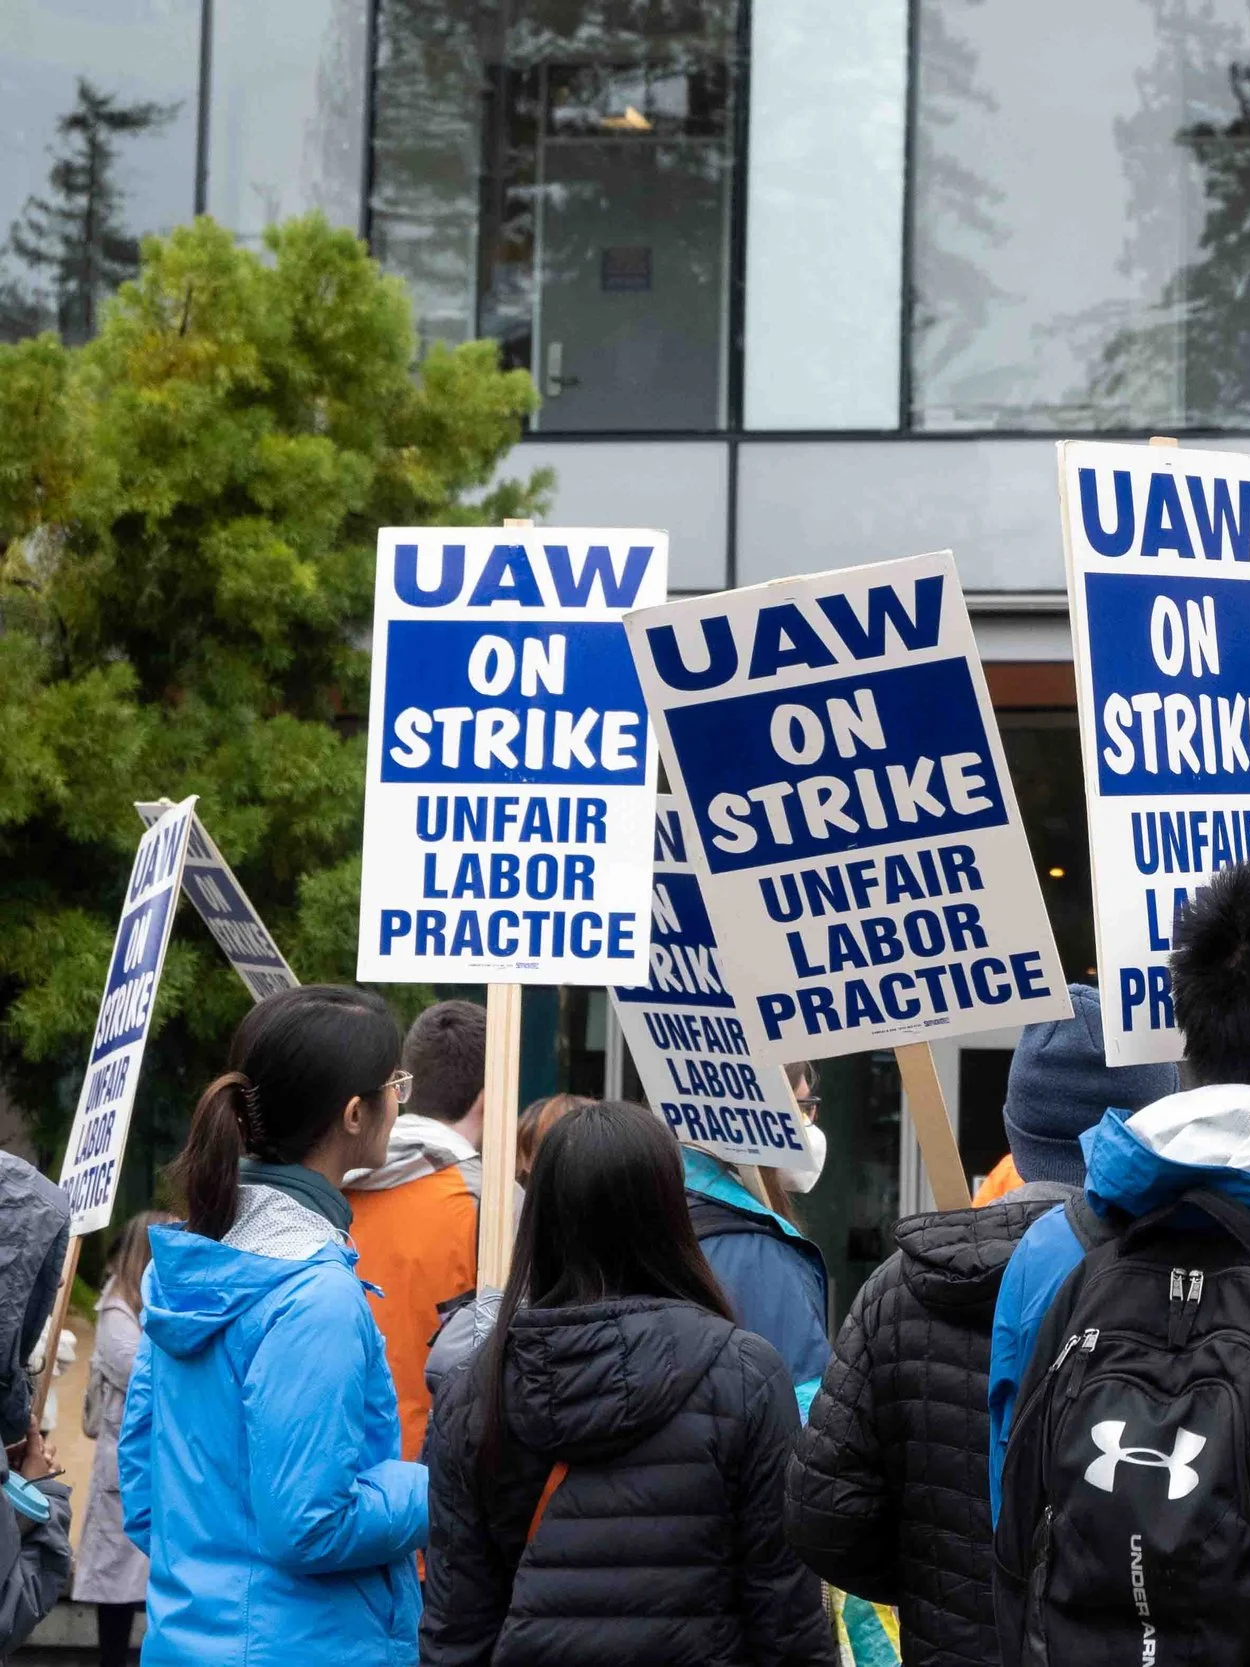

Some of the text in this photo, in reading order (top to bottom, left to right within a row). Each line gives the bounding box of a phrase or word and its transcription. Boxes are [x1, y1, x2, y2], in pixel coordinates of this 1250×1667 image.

[394, 544, 655, 608] UAW
[646, 575, 945, 691] UAW
[1150, 595, 1220, 678] ON
[468, 634, 567, 697] ON
[389, 707, 641, 771] STRIKE
[769, 688, 887, 765] ON
[416, 796, 607, 844] UNFAIR
[707, 752, 994, 855] STRIKE
[130, 815, 187, 904] UAW
[423, 853, 595, 901] LABOR
[758, 844, 985, 923] UNFAIR
[194, 874, 232, 913] ON
[651, 883, 682, 935] N
[123, 908, 152, 973] ON
[379, 909, 636, 959] PRACTICE
[786, 903, 989, 979] LABOR
[621, 942, 733, 996] RIK
[756, 950, 1051, 1042] PRACTICE
[96, 971, 154, 1050] STRIKE
[643, 1011, 750, 1056] UNFAIR
[85, 1055, 130, 1115] UNFAIR
[666, 1058, 765, 1102] LABOR
[74, 1110, 116, 1166] LABOR
[661, 1103, 803, 1151] PRACTICE
[1130, 1534, 1150, 1616] UNDER
